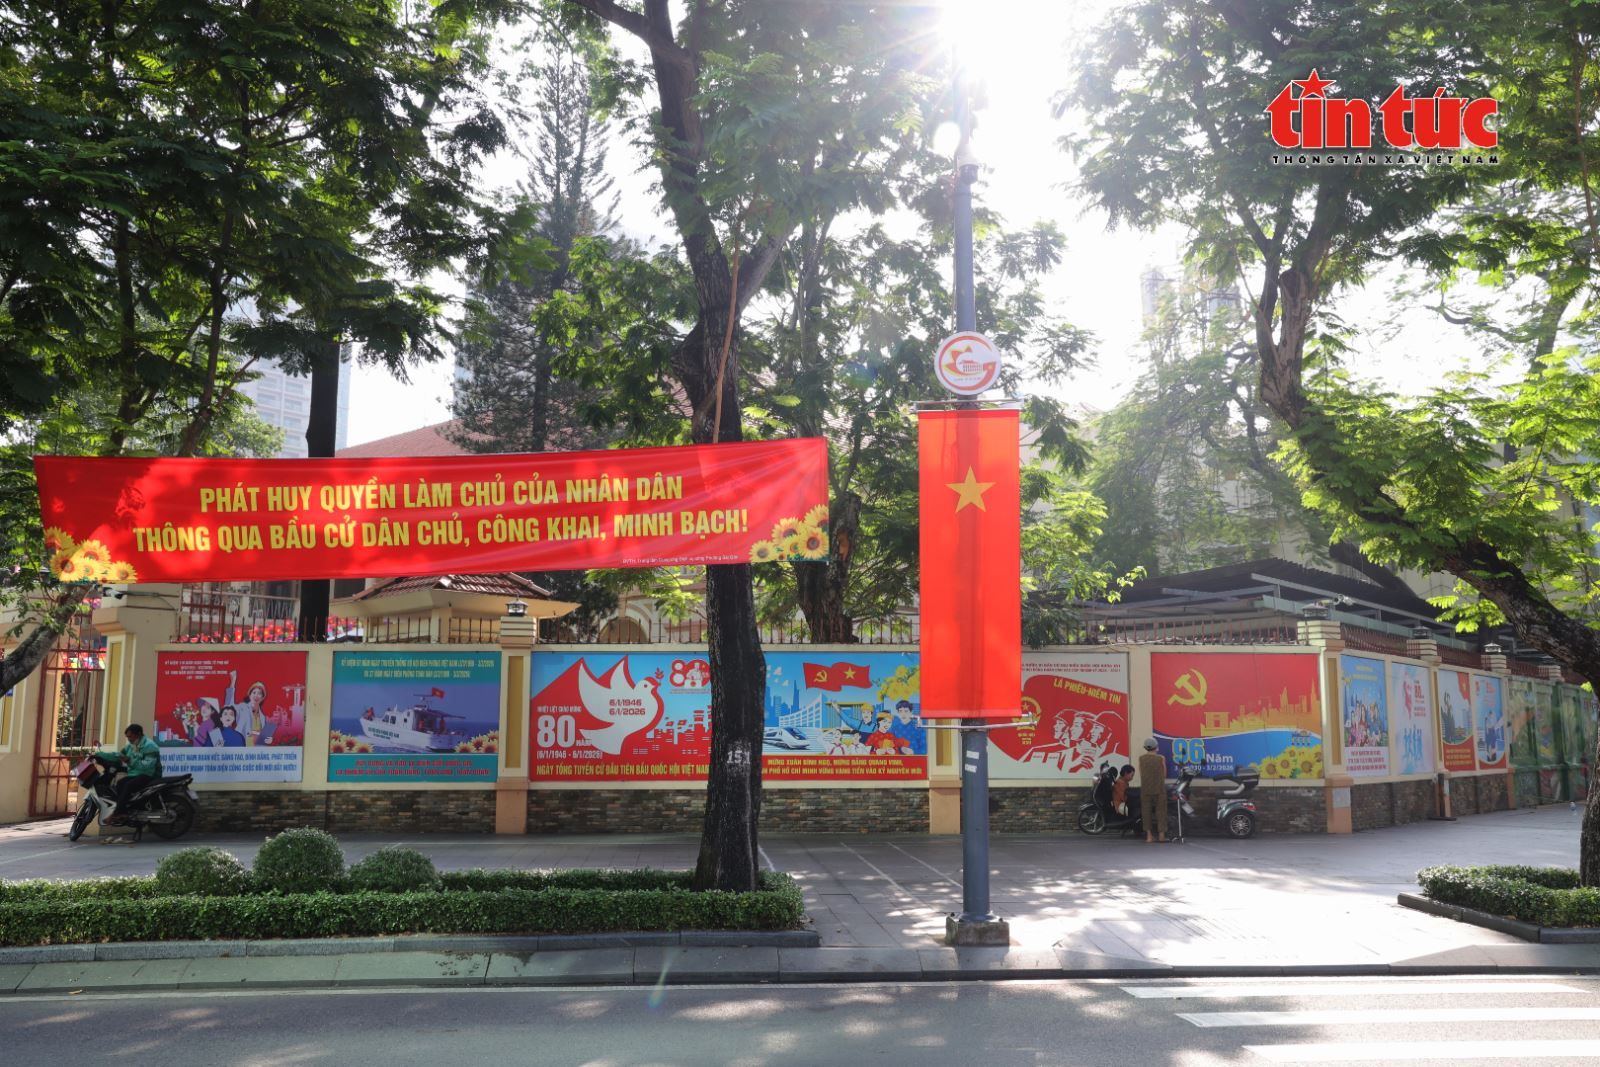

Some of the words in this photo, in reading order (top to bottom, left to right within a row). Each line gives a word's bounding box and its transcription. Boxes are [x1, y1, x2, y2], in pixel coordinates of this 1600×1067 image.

[200, 482, 260, 512] PHÁT
[267, 485, 313, 511] HUY
[320, 476, 396, 513] QUYỀN
[403, 478, 453, 508] LÀM
[460, 473, 506, 507] CHỦ
[513, 472, 559, 505] CỦA
[565, 473, 629, 503] NHÂN
[636, 472, 682, 500] DÂN
[132, 522, 211, 552] THÔNG
[217, 525, 264, 553] QUA
[269, 515, 316, 549] BẦU
[324, 514, 357, 548] CỬ
[362, 517, 410, 546] DÂN
[417, 511, 470, 548] CHỦ,
[477, 513, 539, 544] CÔNG
[547, 515, 606, 542] KHAI,
[613, 512, 673, 538] MINH
[680, 509, 748, 540] BẠCH!
[609, 698, 642, 707] 6/1/1946
[1109, 692, 1121, 705] TIN
[609, 708, 646, 716] 6/1/2026
[537, 715, 576, 748] 80
[1172, 738, 1206, 765] 96
[1206, 753, 1233, 764] Năm
[537, 763, 553, 775] NGÀY
